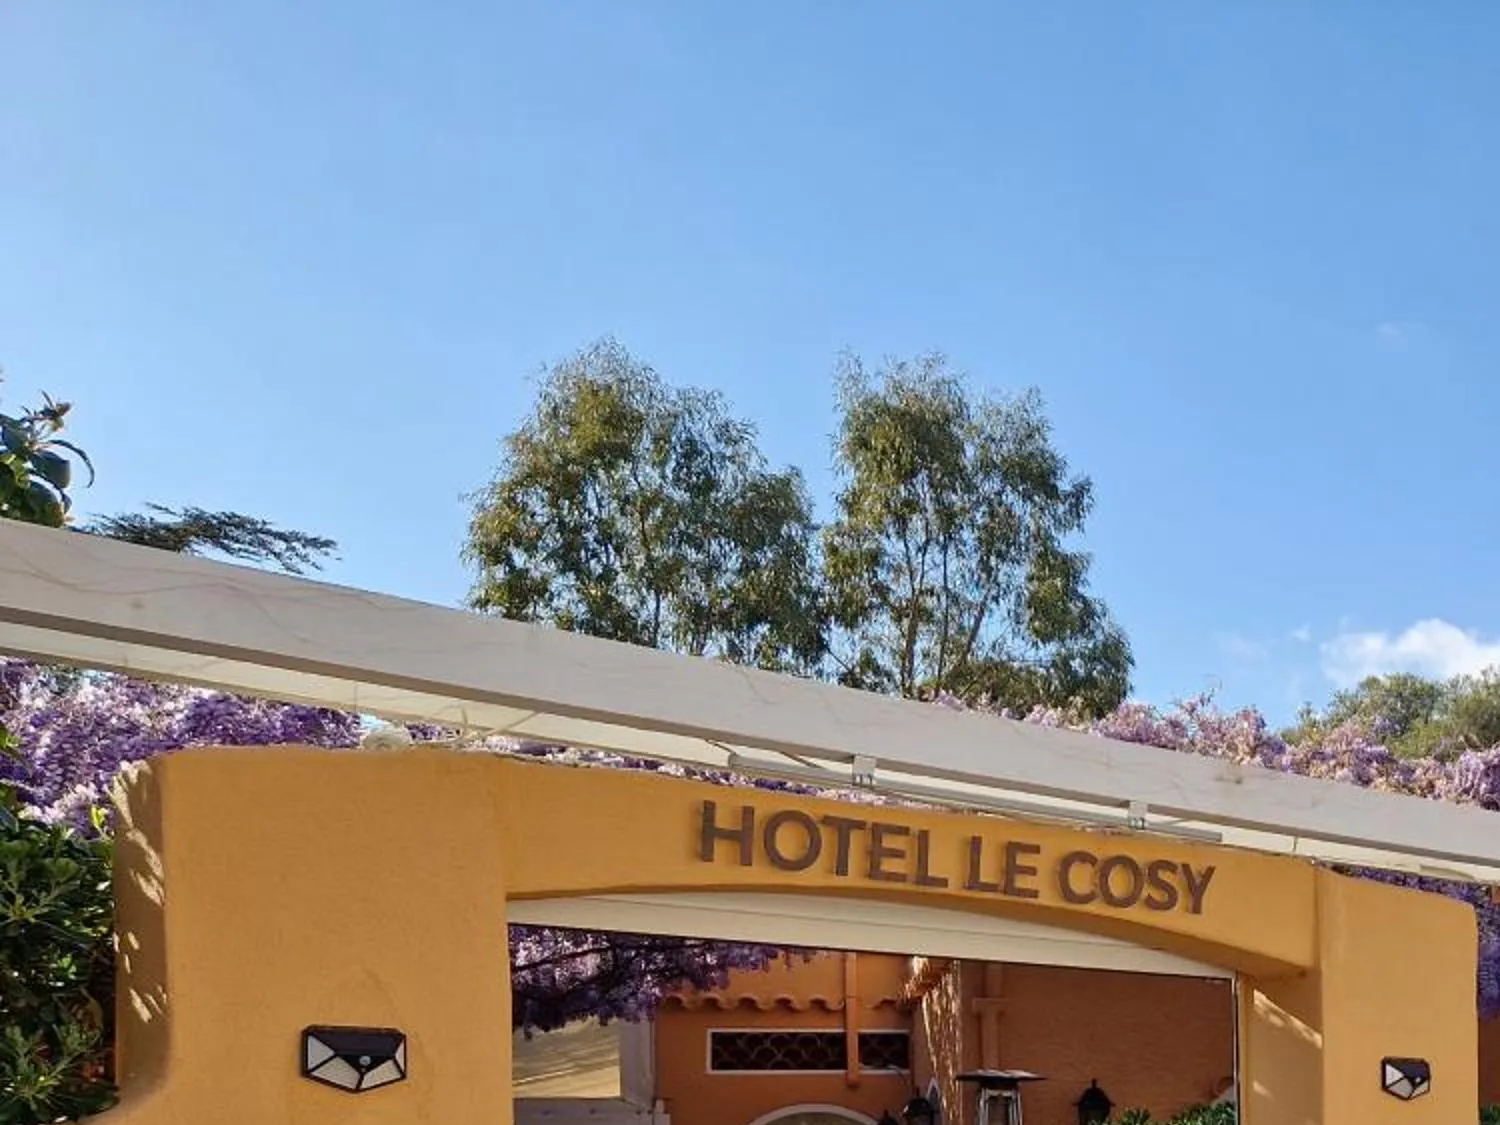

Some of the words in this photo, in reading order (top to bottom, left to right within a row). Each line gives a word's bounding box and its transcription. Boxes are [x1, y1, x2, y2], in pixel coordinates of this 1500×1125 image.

[699, 799, 949, 888] HOTEL
[963, 834, 1041, 898] LE
[1057, 850, 1217, 915] COSY
